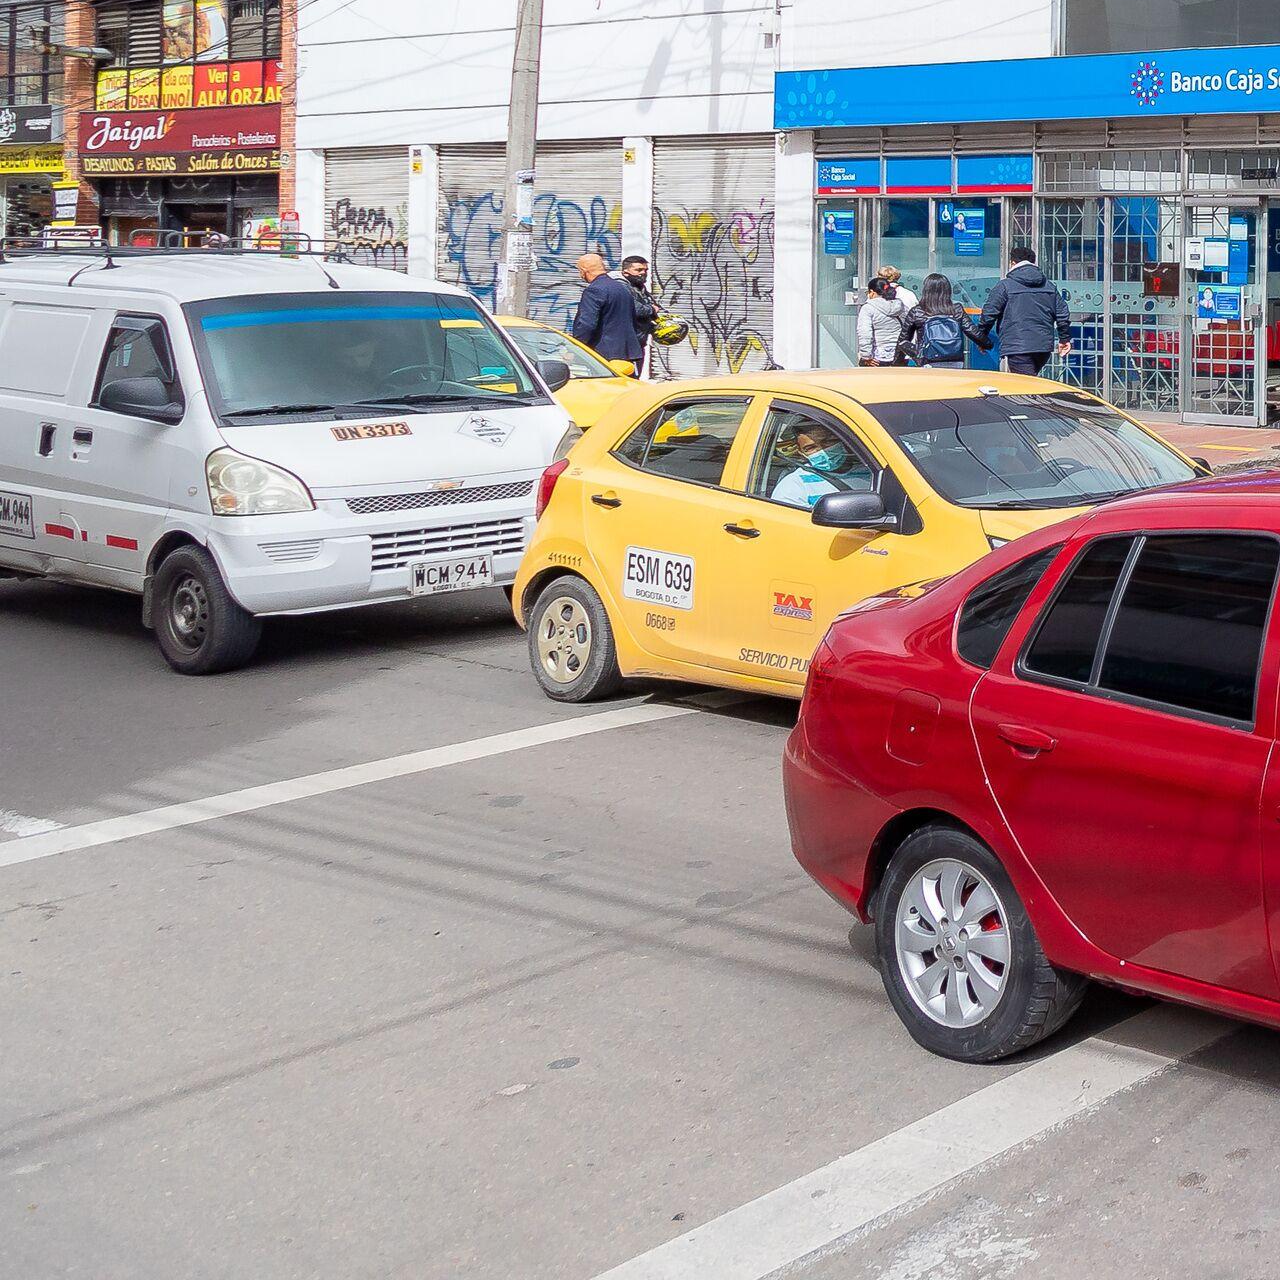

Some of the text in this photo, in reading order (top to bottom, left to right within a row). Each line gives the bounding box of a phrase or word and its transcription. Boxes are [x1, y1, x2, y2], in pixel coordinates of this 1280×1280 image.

[208, 68, 240, 84] Ven a
[1171, 71, 1222, 93] Banco
[1225, 68, 1264, 95] Caja
[86, 115, 166, 150] Jaigal
[84, 158, 134, 172] DESAYUNOS
[145, 156, 176, 171] PASTAS
[188, 152, 220, 172] Salón
[221, 152, 234, 170] de
[235, 153, 268, 170] Onces
[334, 423, 410, 440] UN 3373
[415, 560, 490, 588] WCM 944
[627, 552, 692, 592] ESM 639
[636, 589, 664, 602] BOGOTA
[665, 594, 680, 605] D.C.
[774, 592, 813, 610] TAX
[645, 612, 667, 631] 0668
[773, 605, 812, 620] express
[738, 646, 788, 669] SERVICIO
